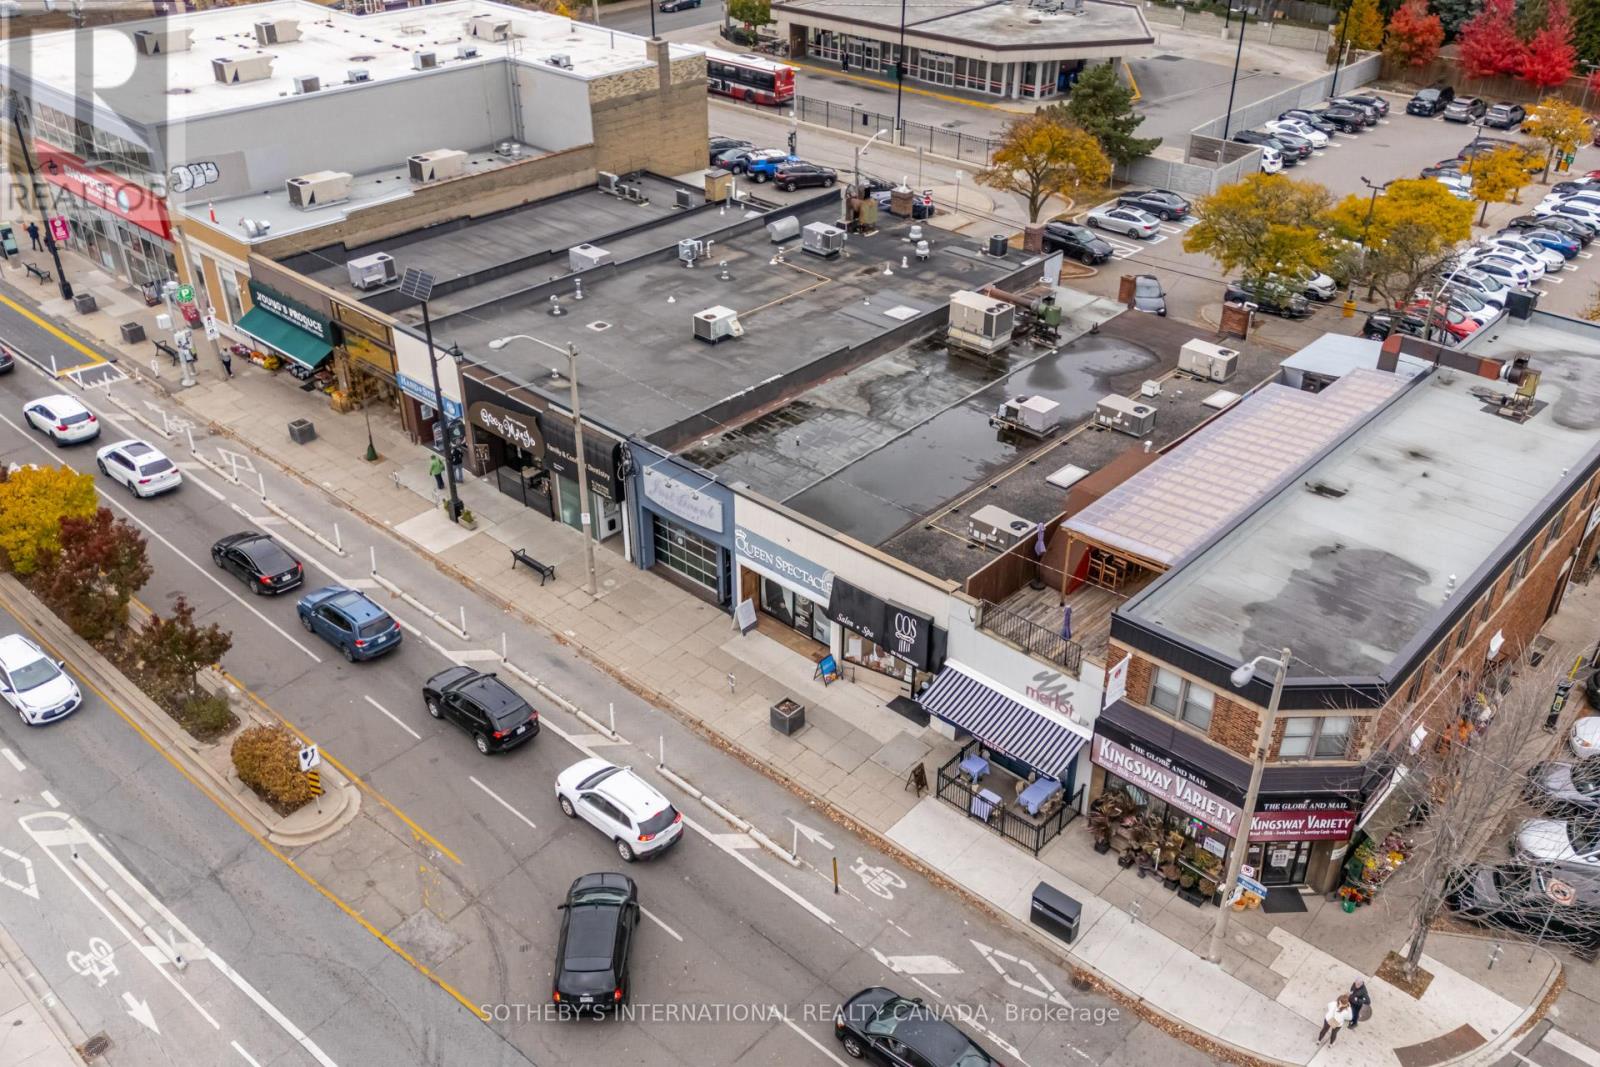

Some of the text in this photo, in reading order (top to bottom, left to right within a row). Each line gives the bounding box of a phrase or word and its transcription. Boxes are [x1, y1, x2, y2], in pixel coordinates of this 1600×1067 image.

[288, 307, 324, 333] PRODUCE
[735, 536, 774, 565] QUEEN
[837, 613, 875, 638] Salon Spa
[895, 612, 917, 640] COS
[1025, 686, 1074, 718] merlot
[1130, 743, 1208, 788] THE GLOBE AND MAIL
[1099, 738, 1236, 824] KINGSWAY VARIETY
[1281, 802, 1308, 810] GLOBE
[1250, 815, 1352, 830] KINGSWAY VARIETY
